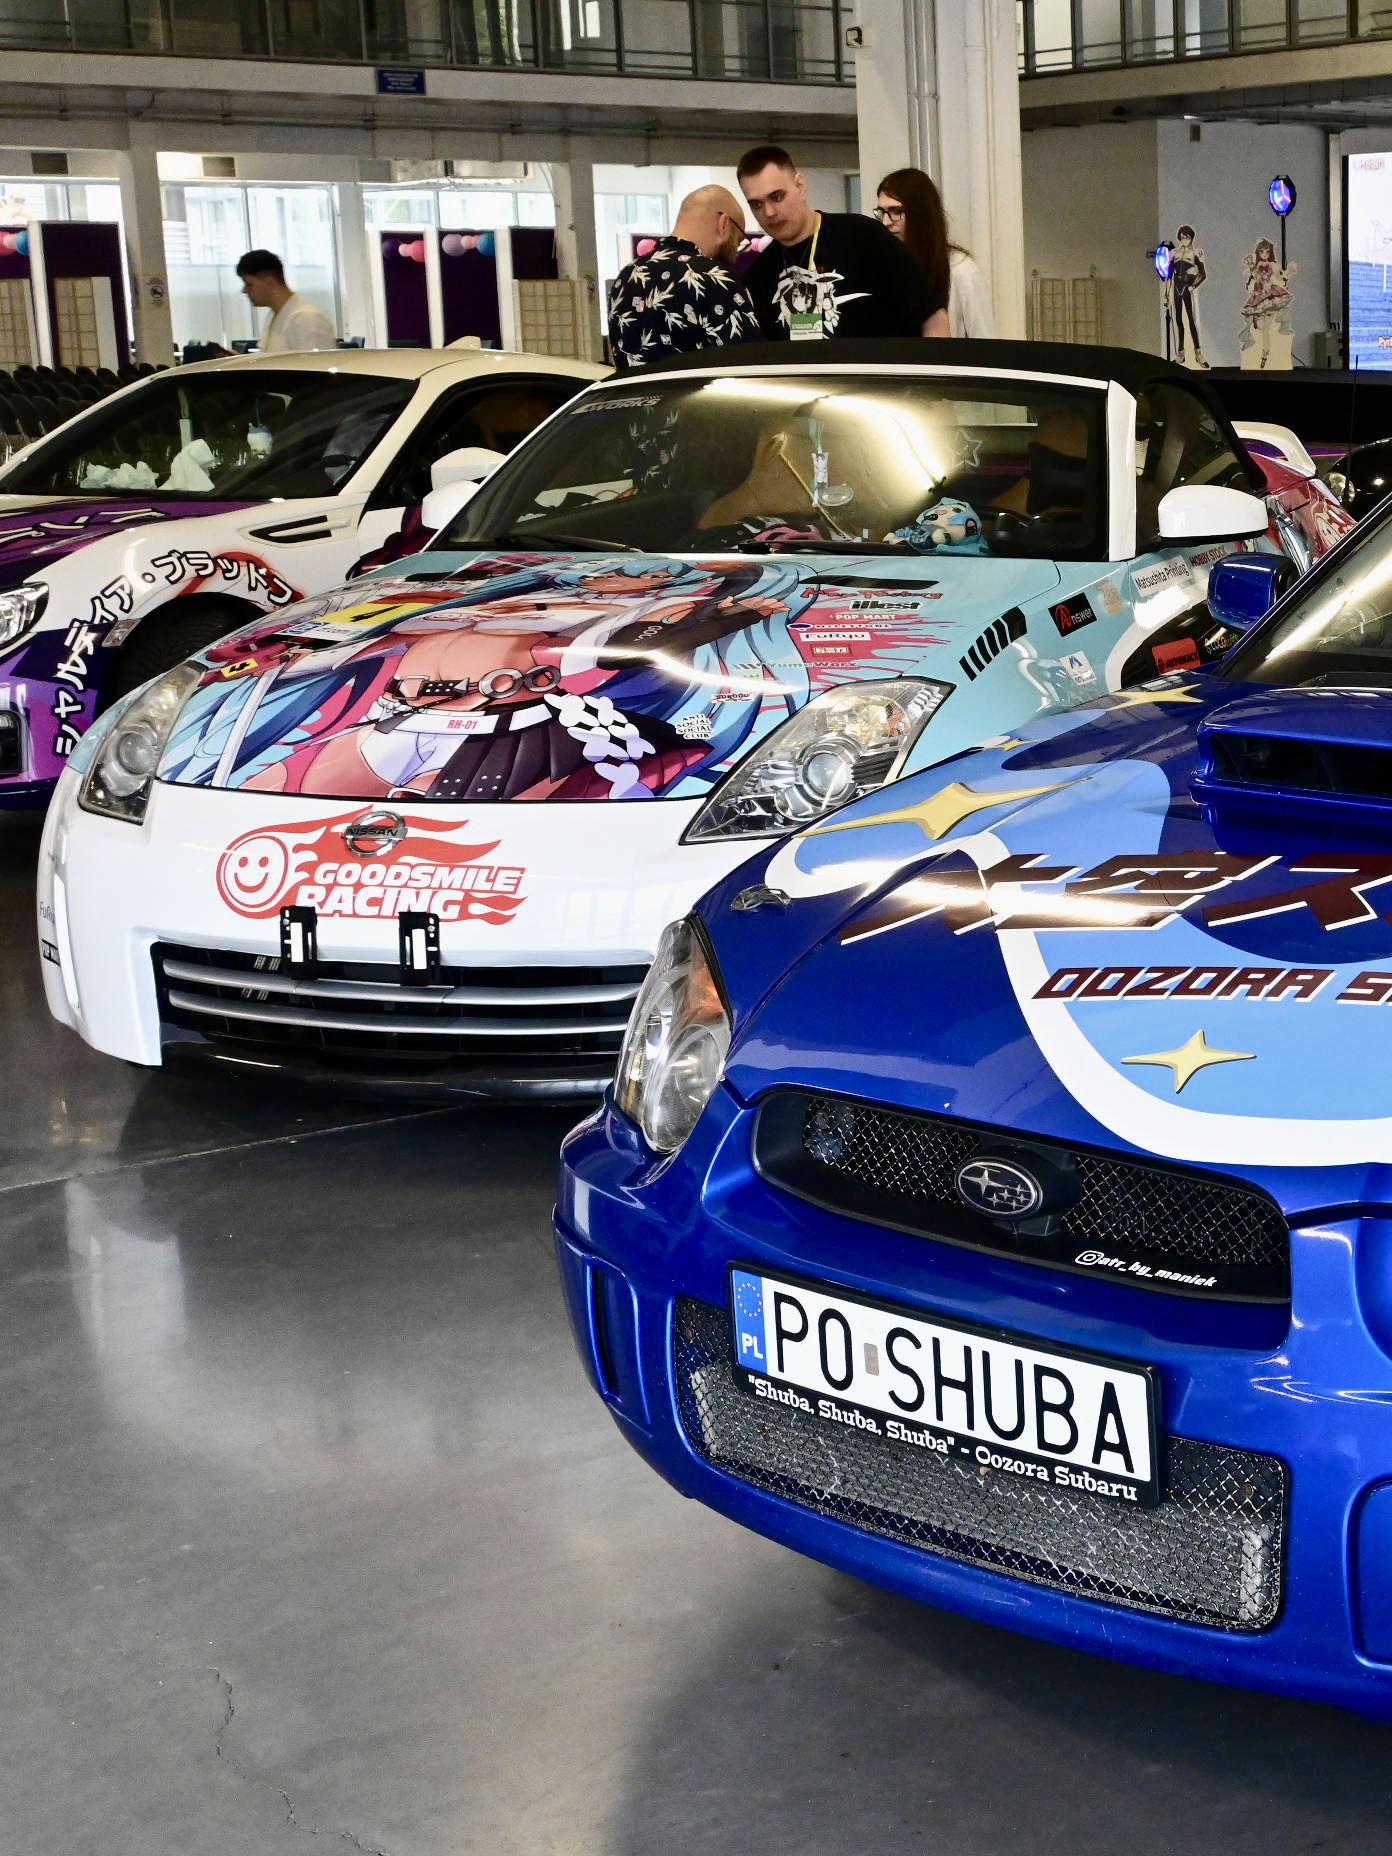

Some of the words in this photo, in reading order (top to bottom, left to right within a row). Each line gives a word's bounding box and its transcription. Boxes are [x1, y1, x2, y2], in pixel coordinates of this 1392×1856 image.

[1135, 569, 1168, 588] Matsushita
[1164, 562, 1190, 579] Printing
[851, 600, 922, 609] illest
[1055, 603, 1094, 633] Answer
[228, 661, 251, 673] 4
[676, 719, 710, 728] SOCIAL
[677, 725, 711, 734] SOCIAL
[346, 826, 400, 838] NISSAN
[313, 862, 523, 893] GOODSMILE
[295, 885, 465, 917] RACING
[1031, 965, 1335, 1002] OOZORA
[742, 1332, 764, 1360] PL
[774, 1291, 854, 1391] PO
[887, 1328, 1136, 1475] SHUBA
[748, 1375, 815, 1415] "Shuba,
[817, 1399, 882, 1436] Shuba,
[885, 1419, 955, 1454] Shuba"
[976, 1447, 1049, 1482] Oozora
[1055, 1467, 1138, 1502] Subaru
